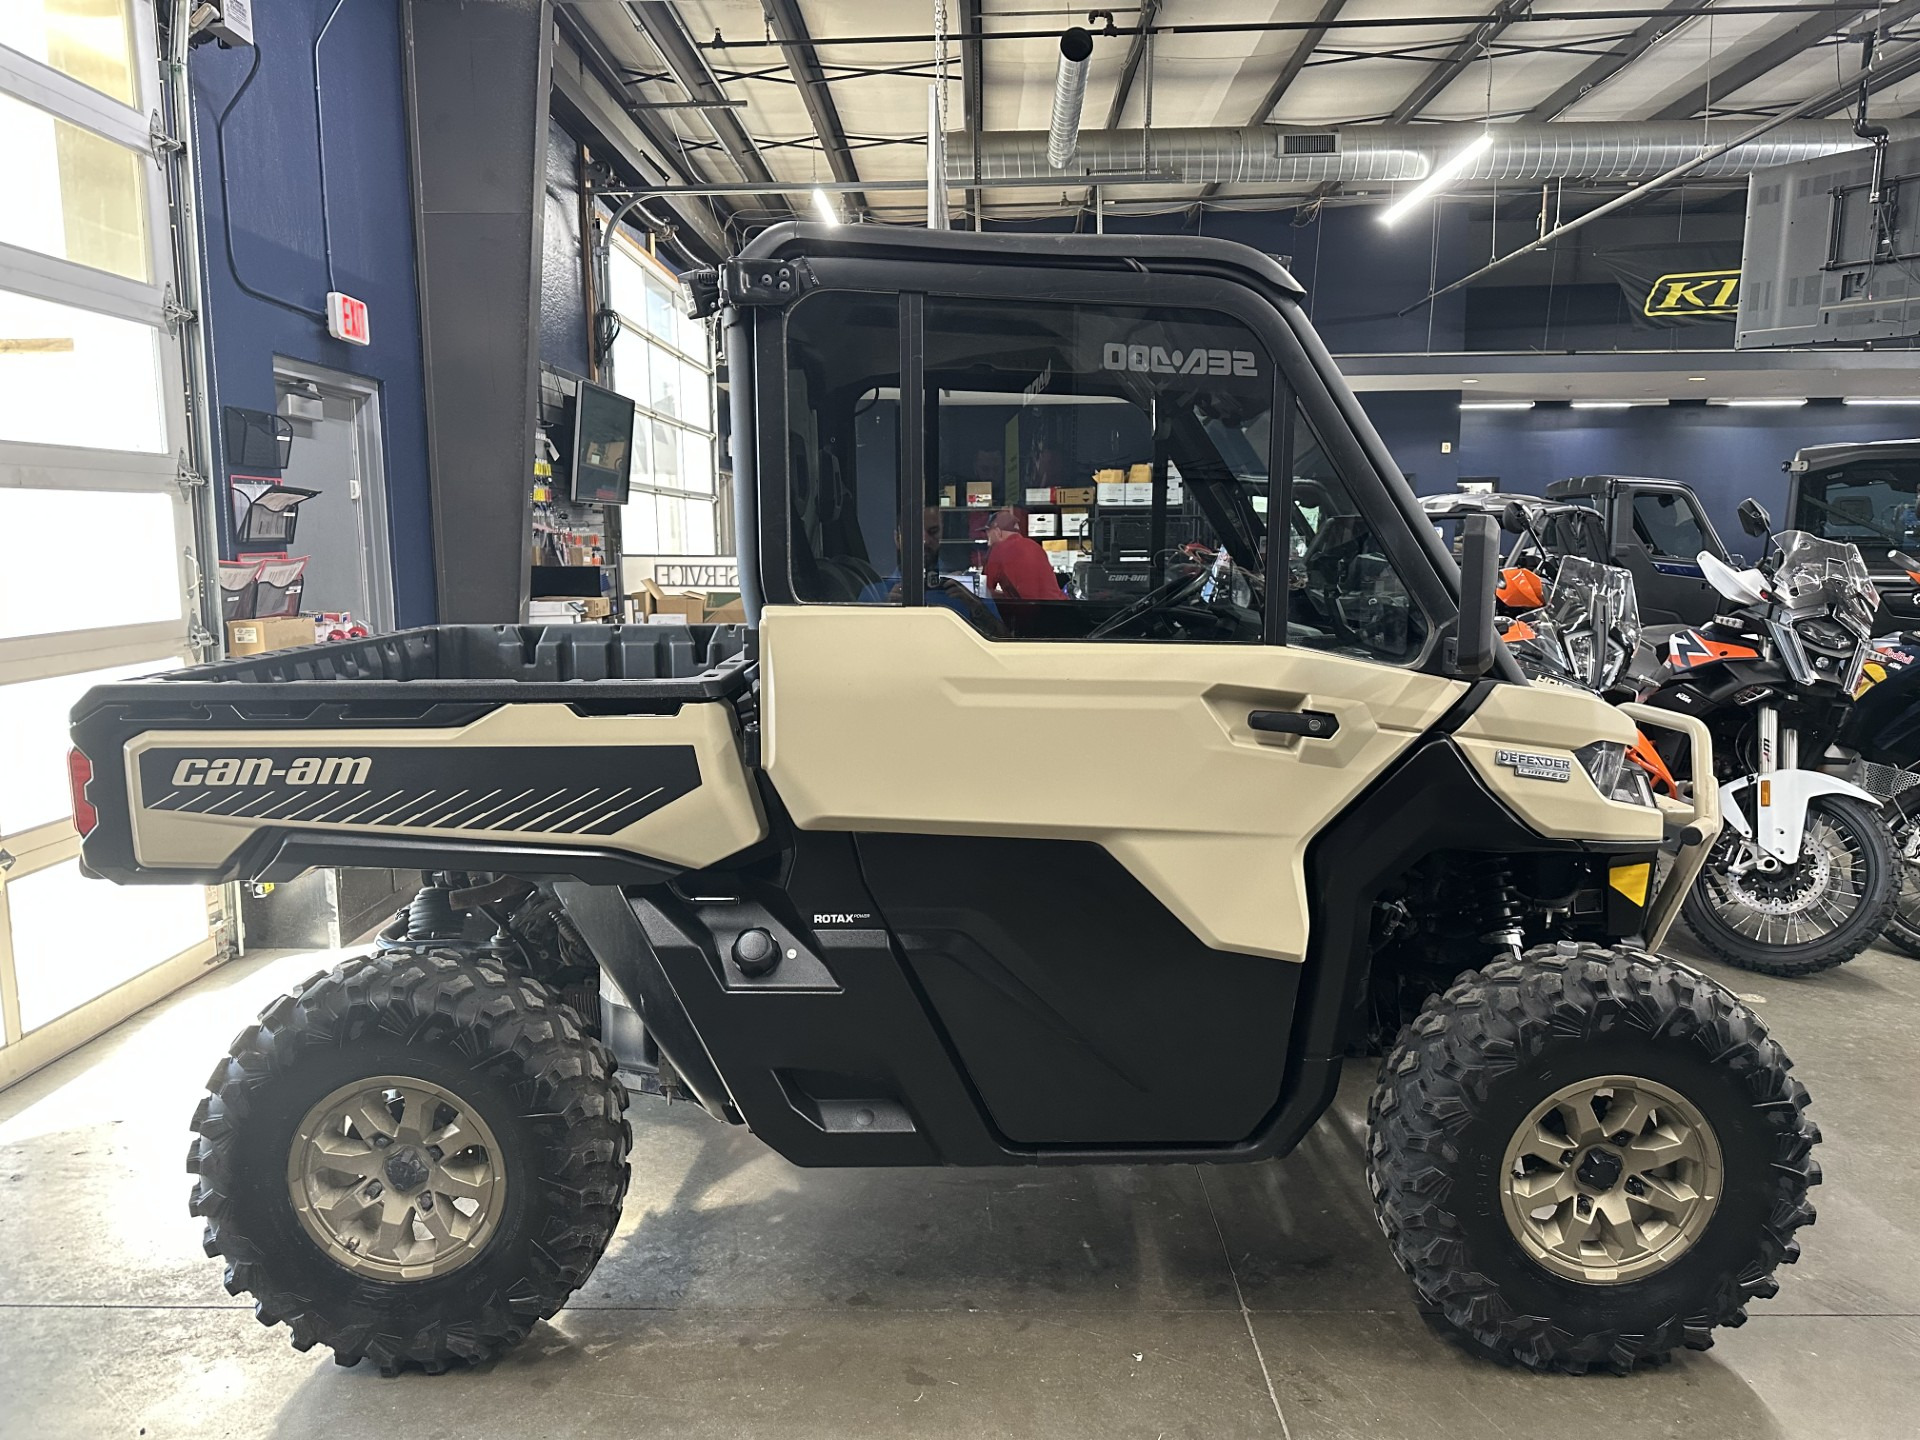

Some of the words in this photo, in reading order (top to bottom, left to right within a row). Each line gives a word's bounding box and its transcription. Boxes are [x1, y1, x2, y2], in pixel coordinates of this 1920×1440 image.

[1656, 278, 1739, 308] KI
[342, 297, 366, 342] EXIT
[1108, 574, 1148, 582] can-am
[171, 756, 372, 786] can-am
[1500, 750, 1570, 769] DEFENDER
[813, 914, 854, 924] ROTAX
